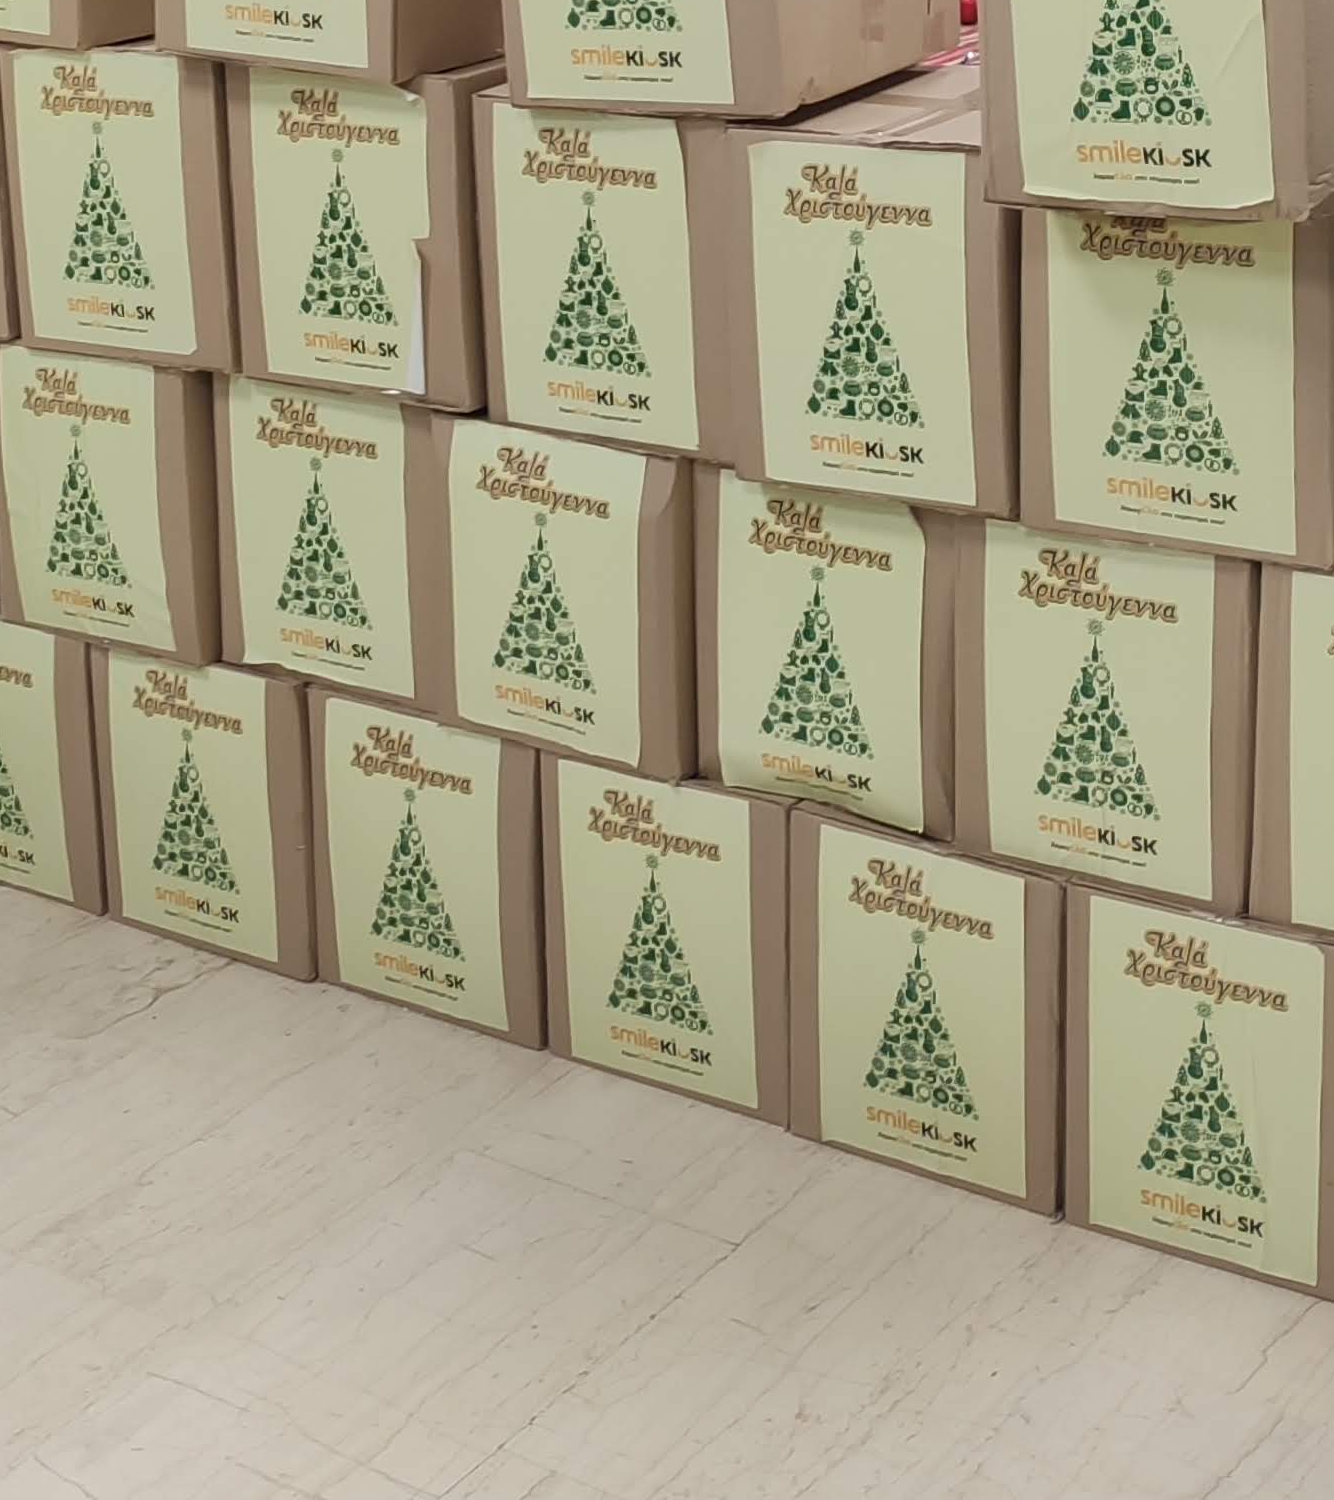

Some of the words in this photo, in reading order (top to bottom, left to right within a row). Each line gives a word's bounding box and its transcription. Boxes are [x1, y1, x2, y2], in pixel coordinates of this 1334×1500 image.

[53, 65, 97, 94] Καλά
[291, 88, 338, 122] Καλά
[538, 127, 592, 162] Καλά
[801, 163, 859, 200] Καλά
[35, 367, 78, 399] Καλά
[271, 397, 317, 430] Καλά
[498, 446, 548, 483] Καλά
[767, 498, 823, 536] Καλά
[1038, 546, 1099, 588] Καλά
[146, 670, 189, 704] Καλά
[366, 725, 414, 761] Καλά
[603, 789, 654, 827] Καλά
[867, 859, 924, 897] Καλά
[1145, 928, 1210, 972] Καλά
